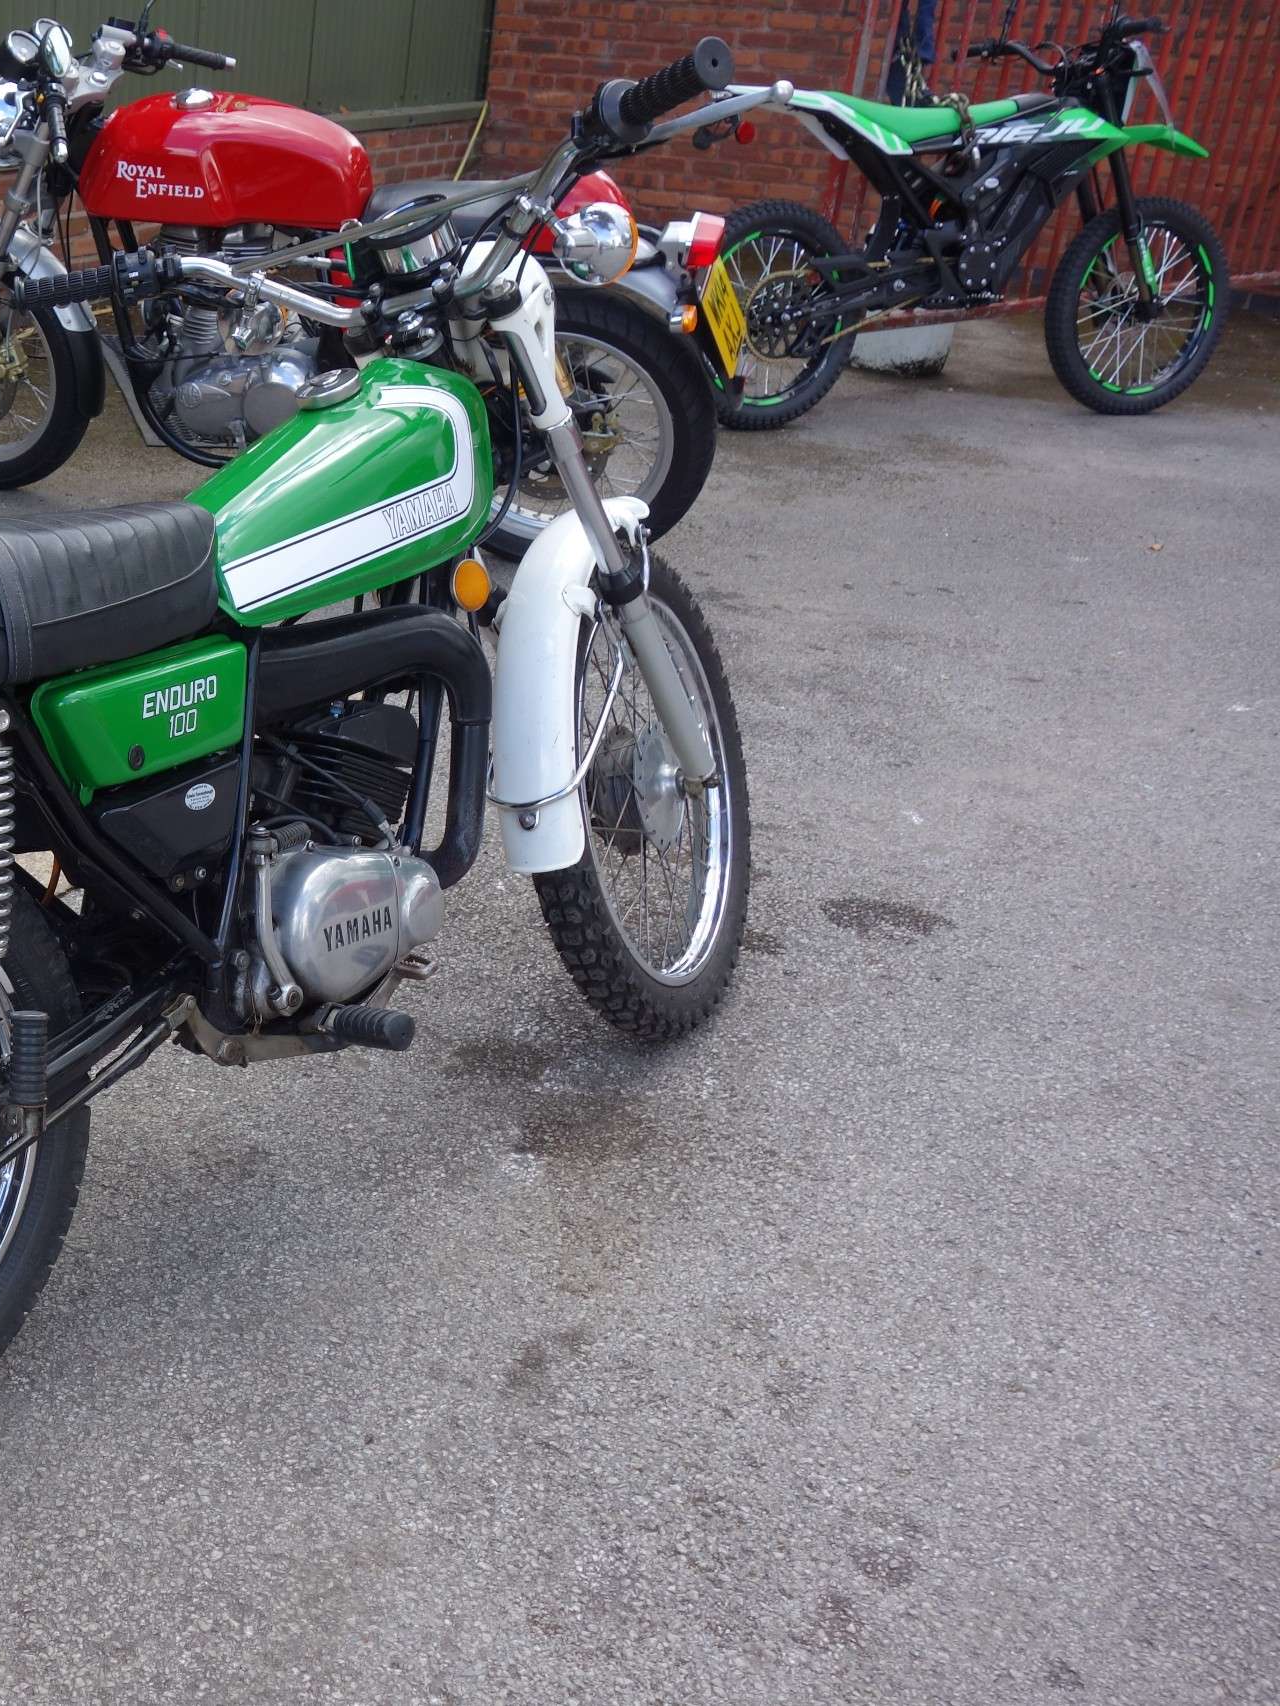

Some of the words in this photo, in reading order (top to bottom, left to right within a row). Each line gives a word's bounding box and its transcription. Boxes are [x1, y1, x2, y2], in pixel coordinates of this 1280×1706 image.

[382, 483, 458, 539] YAMAHA
[142, 675, 217, 720] ENDURO
[169, 708, 198, 739] 100
[323, 906, 393, 952] YAMAHA
